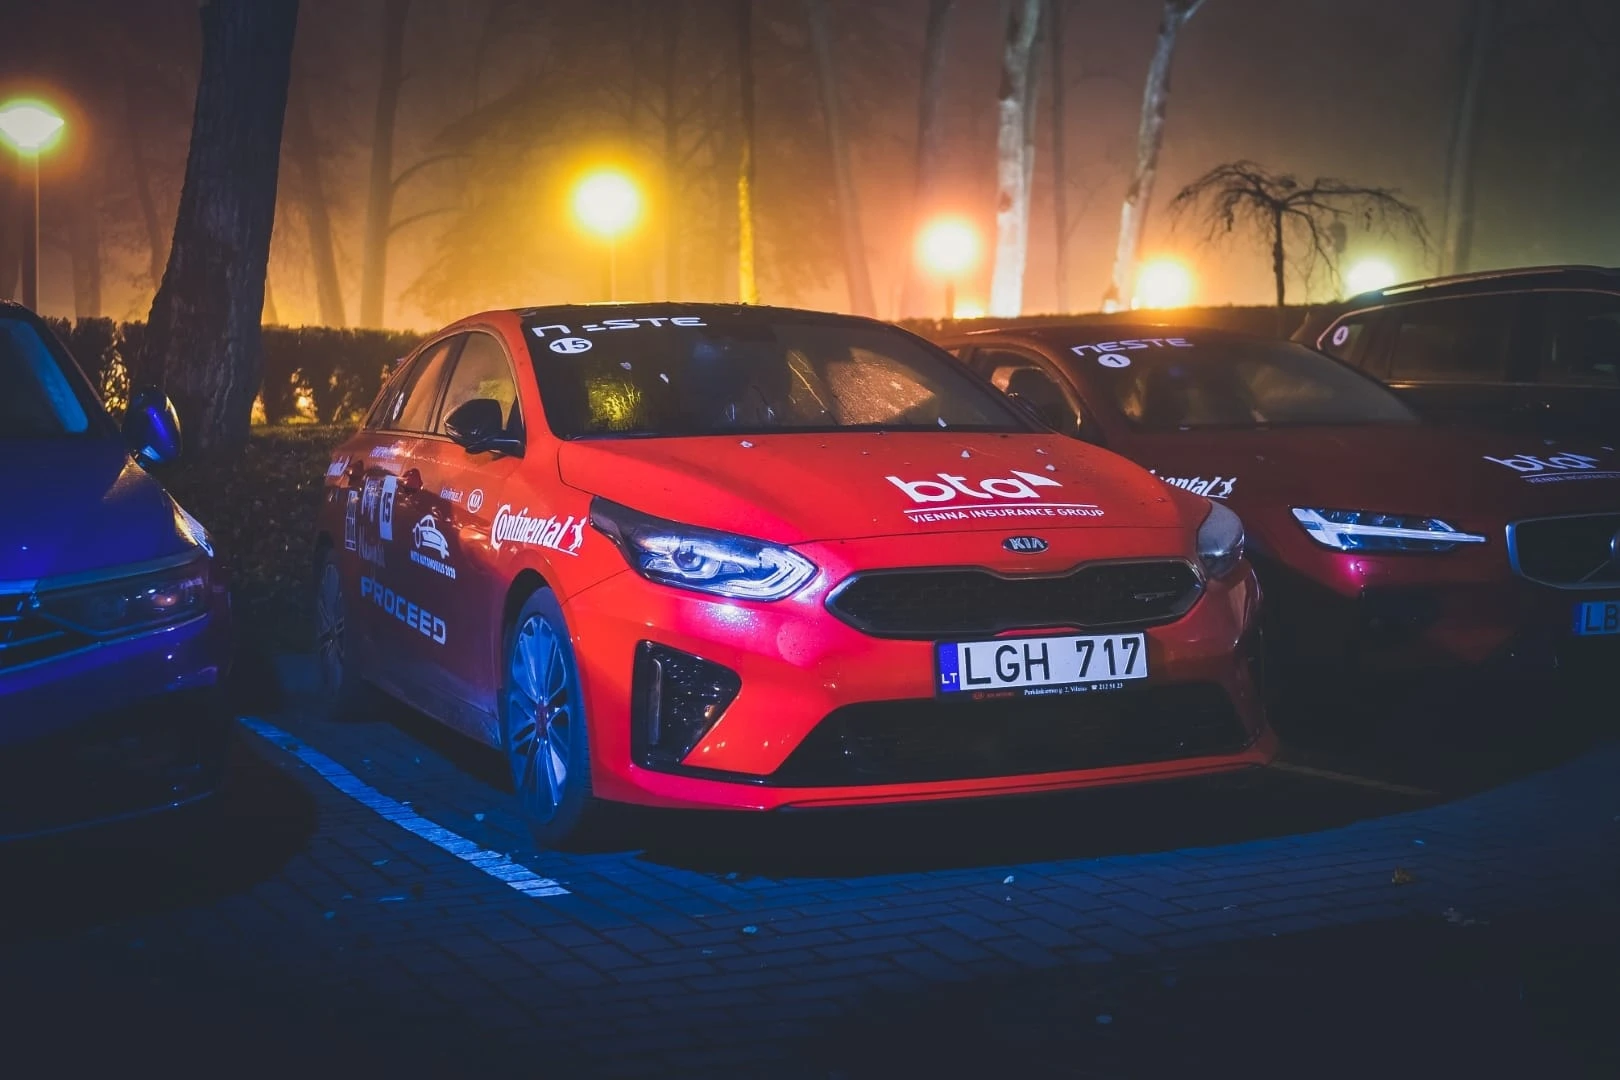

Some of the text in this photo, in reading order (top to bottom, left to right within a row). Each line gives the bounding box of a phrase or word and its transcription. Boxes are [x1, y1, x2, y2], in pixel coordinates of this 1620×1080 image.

[552, 339, 589, 351] 15
[885, 472, 1044, 503] bta
[908, 508, 1105, 523] VIENNA INSURANCE GROUP
[491, 504, 574, 551] Continental
[1009, 537, 1045, 549] KIA
[361, 576, 446, 645] PROCEED
[964, 637, 1140, 685] LGH 717
[941, 673, 957, 684] LT
